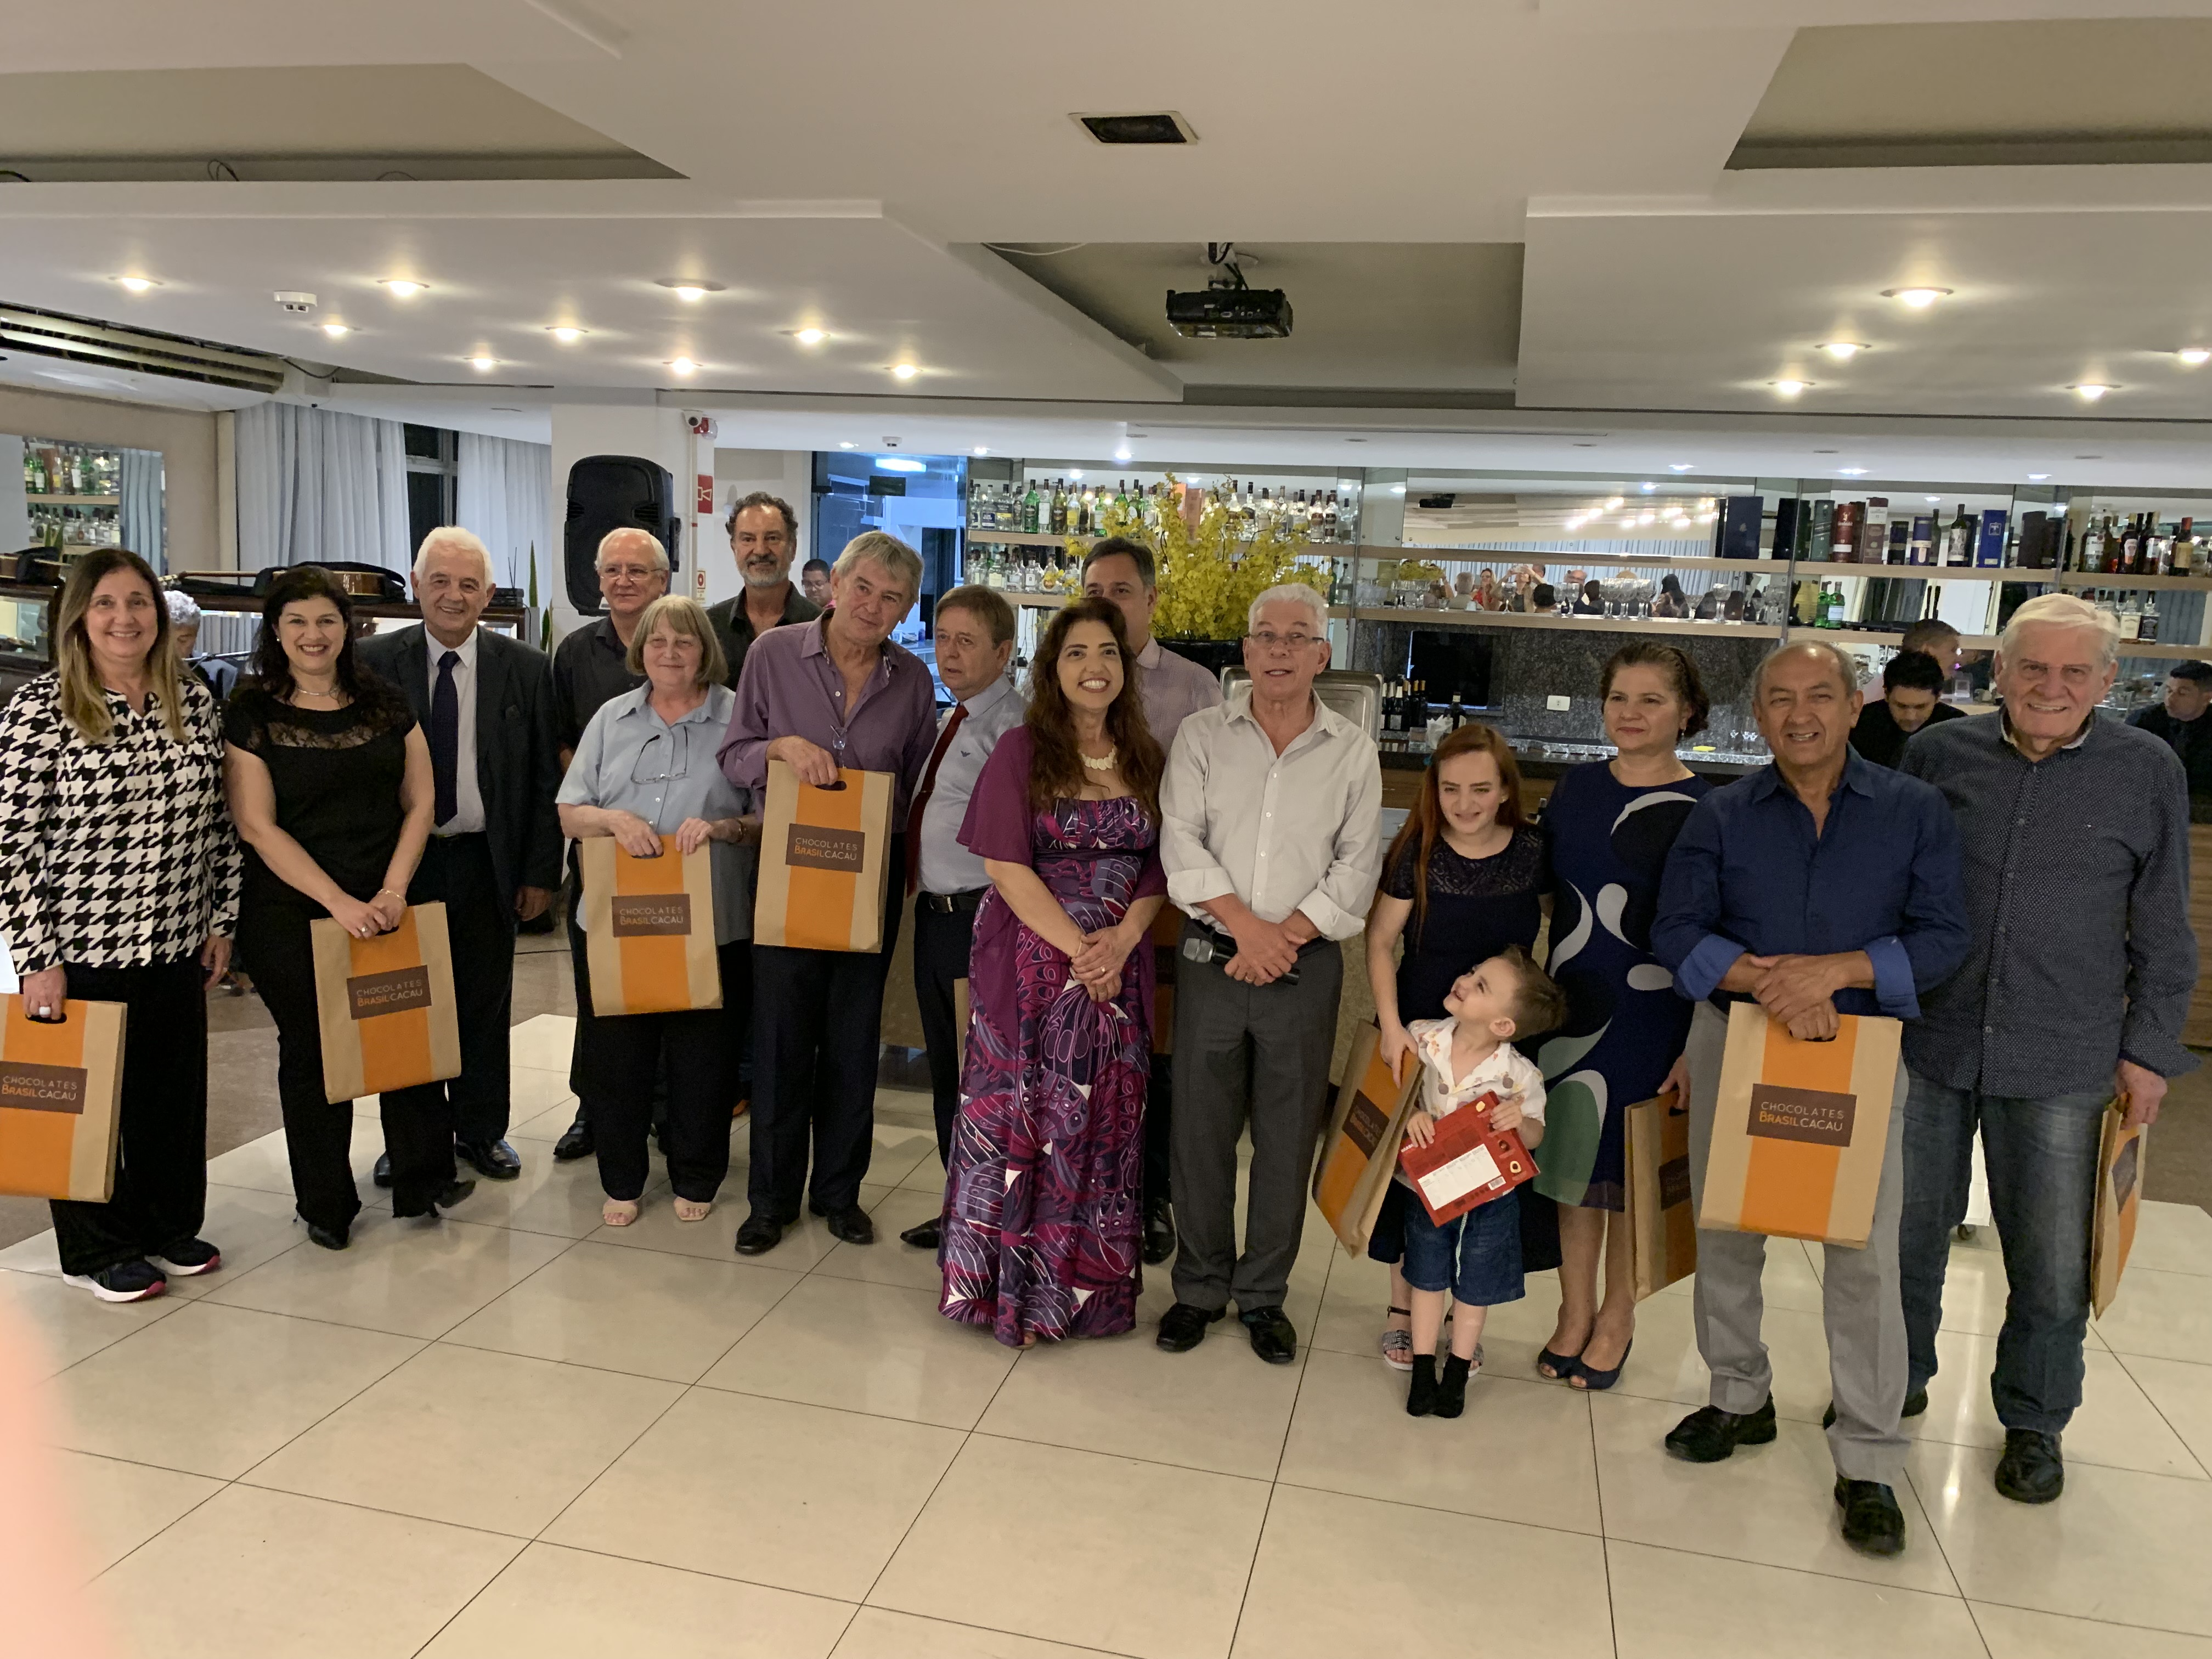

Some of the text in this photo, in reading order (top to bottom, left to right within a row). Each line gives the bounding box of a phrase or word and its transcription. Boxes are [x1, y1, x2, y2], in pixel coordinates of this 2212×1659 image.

[795, 837, 857, 851] CHOCOLATES
[619, 906, 683, 916] CHOCOLATES
[357, 979, 422, 997] CHOCOLATES
[3, 1076, 77, 1090] CHOCOLATES
[1761, 1102, 1844, 1119] CHOCOLATES
